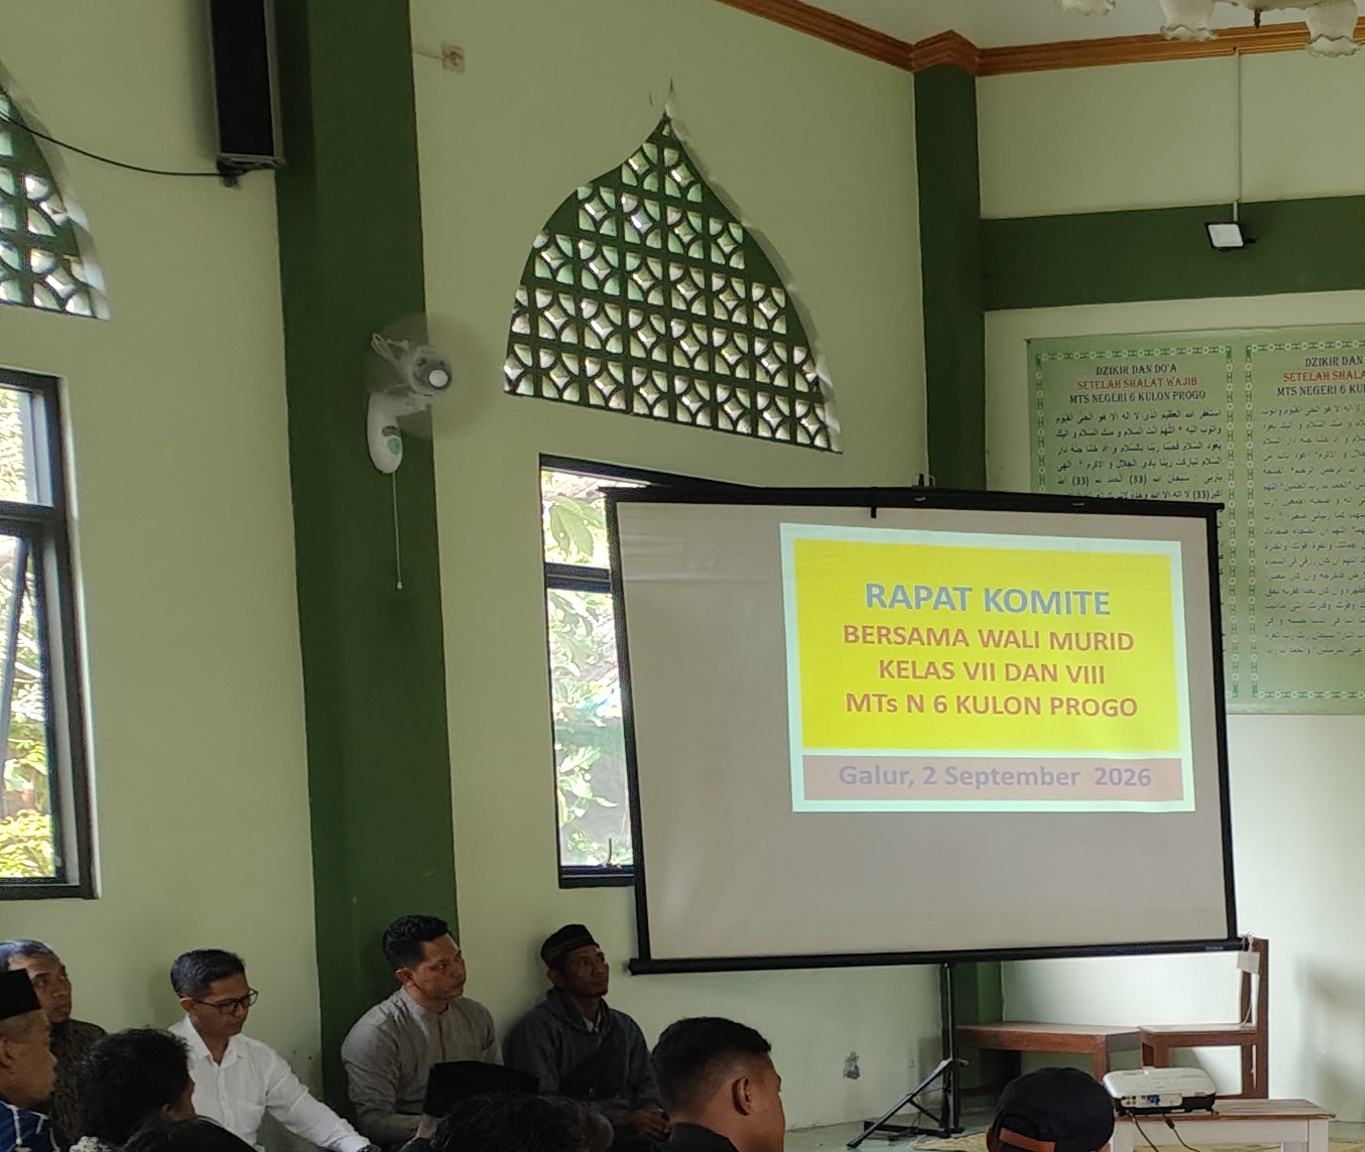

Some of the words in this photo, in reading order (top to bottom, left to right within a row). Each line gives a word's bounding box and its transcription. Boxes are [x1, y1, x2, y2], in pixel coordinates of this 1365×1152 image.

[1306, 357, 1338, 367] DZIKIR
[1342, 356, 1363, 365] DAN
[1097, 366, 1129, 375] DZIKIR
[1132, 365, 1152, 374] DAN
[1284, 372, 1330, 382] SETELAH
[1078, 379, 1121, 390] SETELAH
[1124, 378, 1164, 388] SHALAT
[1166, 377, 1197, 386] WAJIB
[1277, 387, 1297, 396] MTS
[1300, 386, 1336, 395] NEGERI
[1340, 385, 1346, 394] 6
[1070, 394, 1089, 404] MTS
[1092, 393, 1126, 403] NEGERI
[1130, 393, 1135, 402] 6
[1139, 391, 1170, 402] KULON
[1173, 390, 1206, 399] PROGO
[866, 583, 973, 612] RAPAT
[984, 588, 1111, 615] KOMITE
[844, 625, 969, 647] BERSAMA
[978, 629, 1040, 649] WALI
[1050, 632, 1134, 651] MURID
[879, 660, 955, 681] KELAS
[963, 662, 995, 681] VII
[1005, 664, 1057, 683] DAN
[1066, 665, 1105, 684] VIII
[846, 693, 898, 714] MTs
[907, 695, 924, 714] N
[934, 696, 947, 714] 6
[957, 696, 1041, 715] KULON
[1051, 698, 1138, 717] PROGO
[839, 764, 914, 789] Galur,
[923, 767, 936, 785] 2
[946, 766, 1079, 789] September
[1094, 767, 1151, 787] 2026
